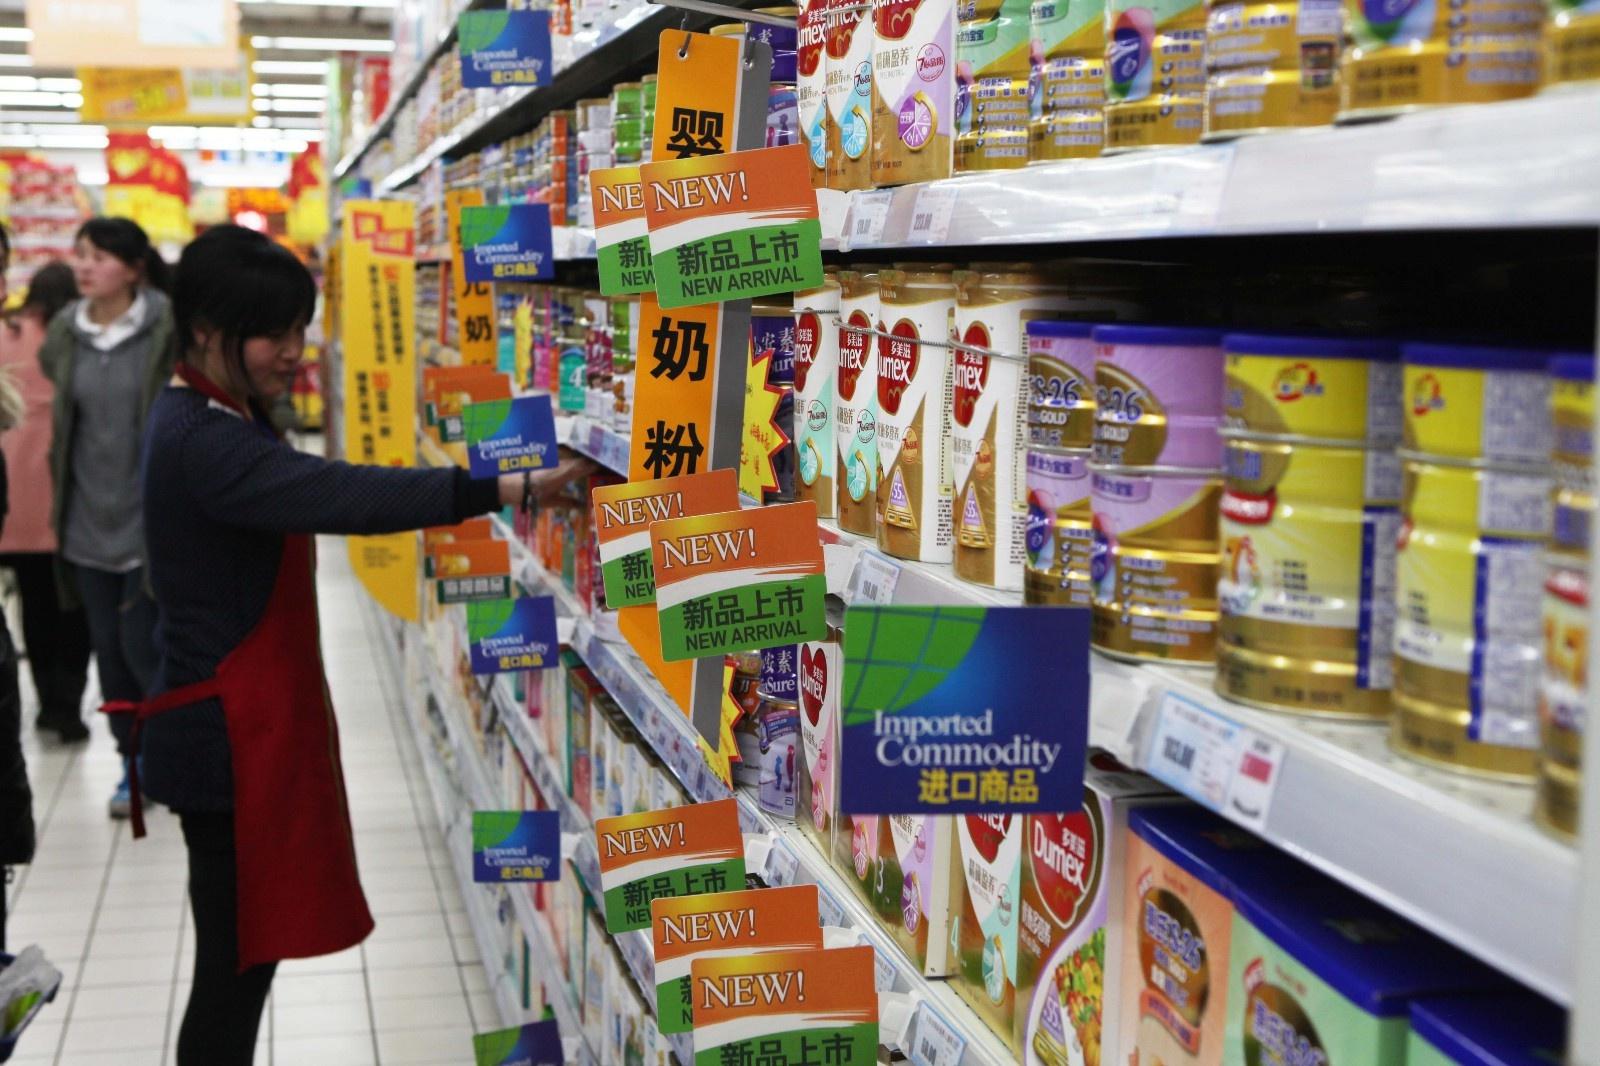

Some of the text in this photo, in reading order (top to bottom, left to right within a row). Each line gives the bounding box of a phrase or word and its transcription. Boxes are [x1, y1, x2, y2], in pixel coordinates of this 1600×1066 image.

[600, 183, 642, 212] NE
[649, 171, 749, 212] NEW!
[618, 240, 652, 269] 新
[677, 230, 800, 277] 新品上市
[681, 266, 804, 298] NEW ARRIVAL
[1040, 410, 1068, 425] GOLD
[602, 492, 684, 528] NEW!
[622, 552, 653, 581] 新
[659, 528, 756, 569] NEW!
[682, 585, 804, 630] 新品上市
[686, 619, 807, 651] NEW ARRIVAL
[874, 709, 993, 741] Imported
[876, 735, 1061, 773] Commodity
[918, 768, 1039, 804] 进口商品
[603, 822, 686, 858] NEW!
[1034, 820, 1087, 894] Dumex
[623, 867, 727, 907] 新品上市
[660, 908, 757, 946] NEW!
[700, 970, 806, 1009] NEW!
